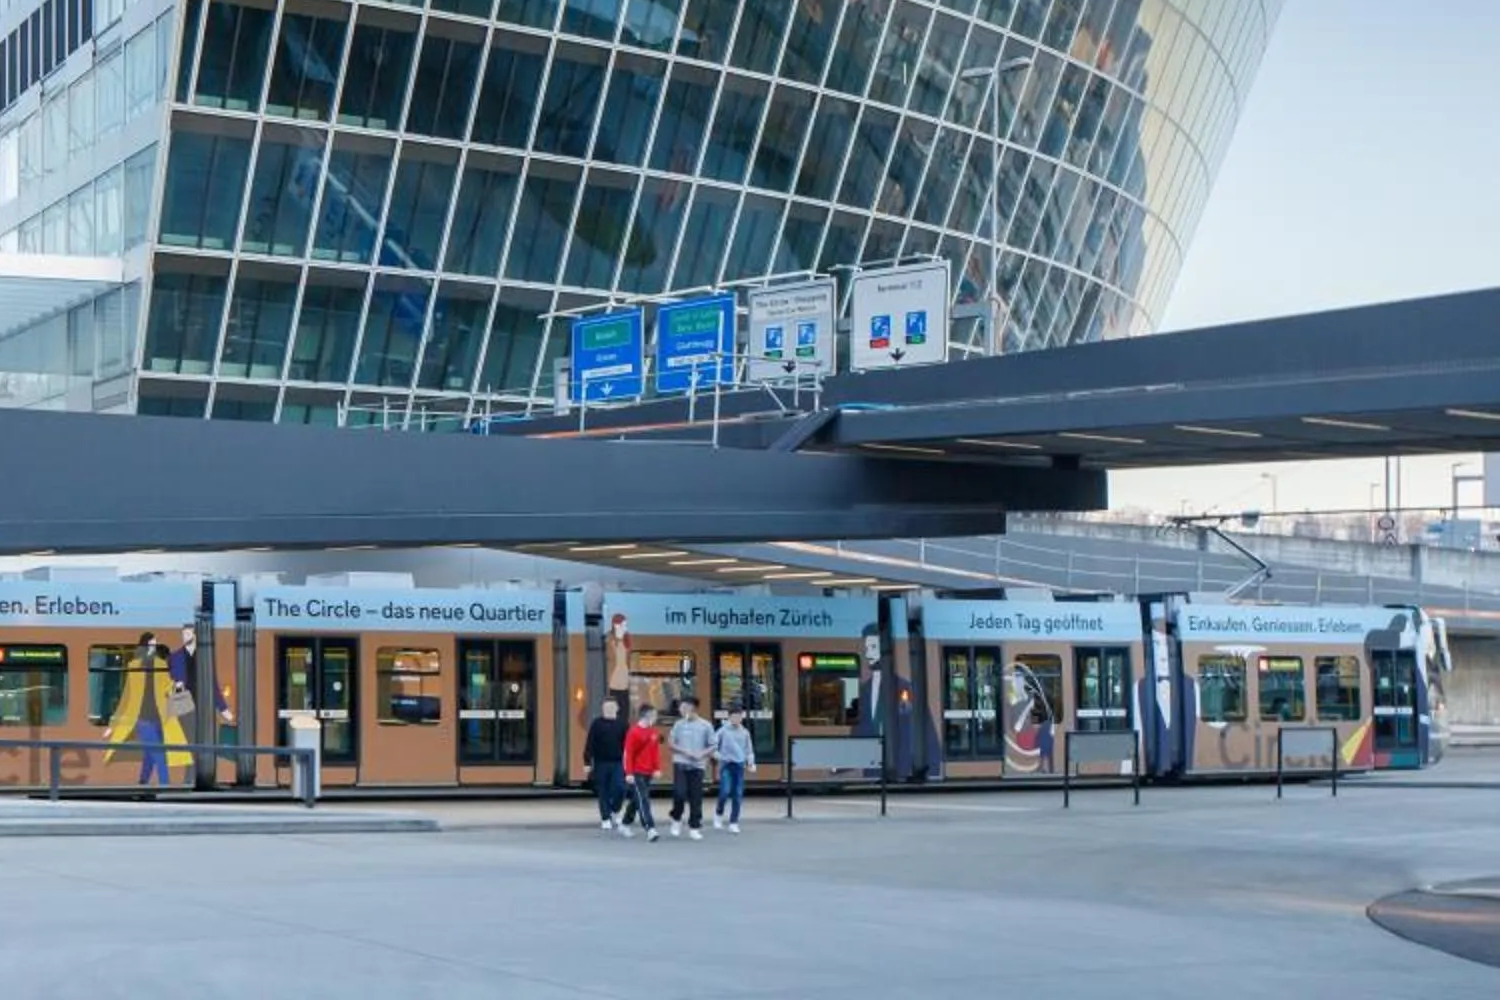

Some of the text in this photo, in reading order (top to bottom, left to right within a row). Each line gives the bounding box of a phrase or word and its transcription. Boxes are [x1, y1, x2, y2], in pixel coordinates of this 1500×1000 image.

[35, 595, 120, 616] Erleben.
[264, 598, 300, 618] The
[306, 599, 361, 618] Circle
[381, 601, 415, 620] das
[419, 606, 465, 621] neue
[469, 603, 545, 623] Quartier
[665, 607, 833, 628] im Flughafen Zürich
[969, 612, 1104, 634] Jeden Tag geöffnet
